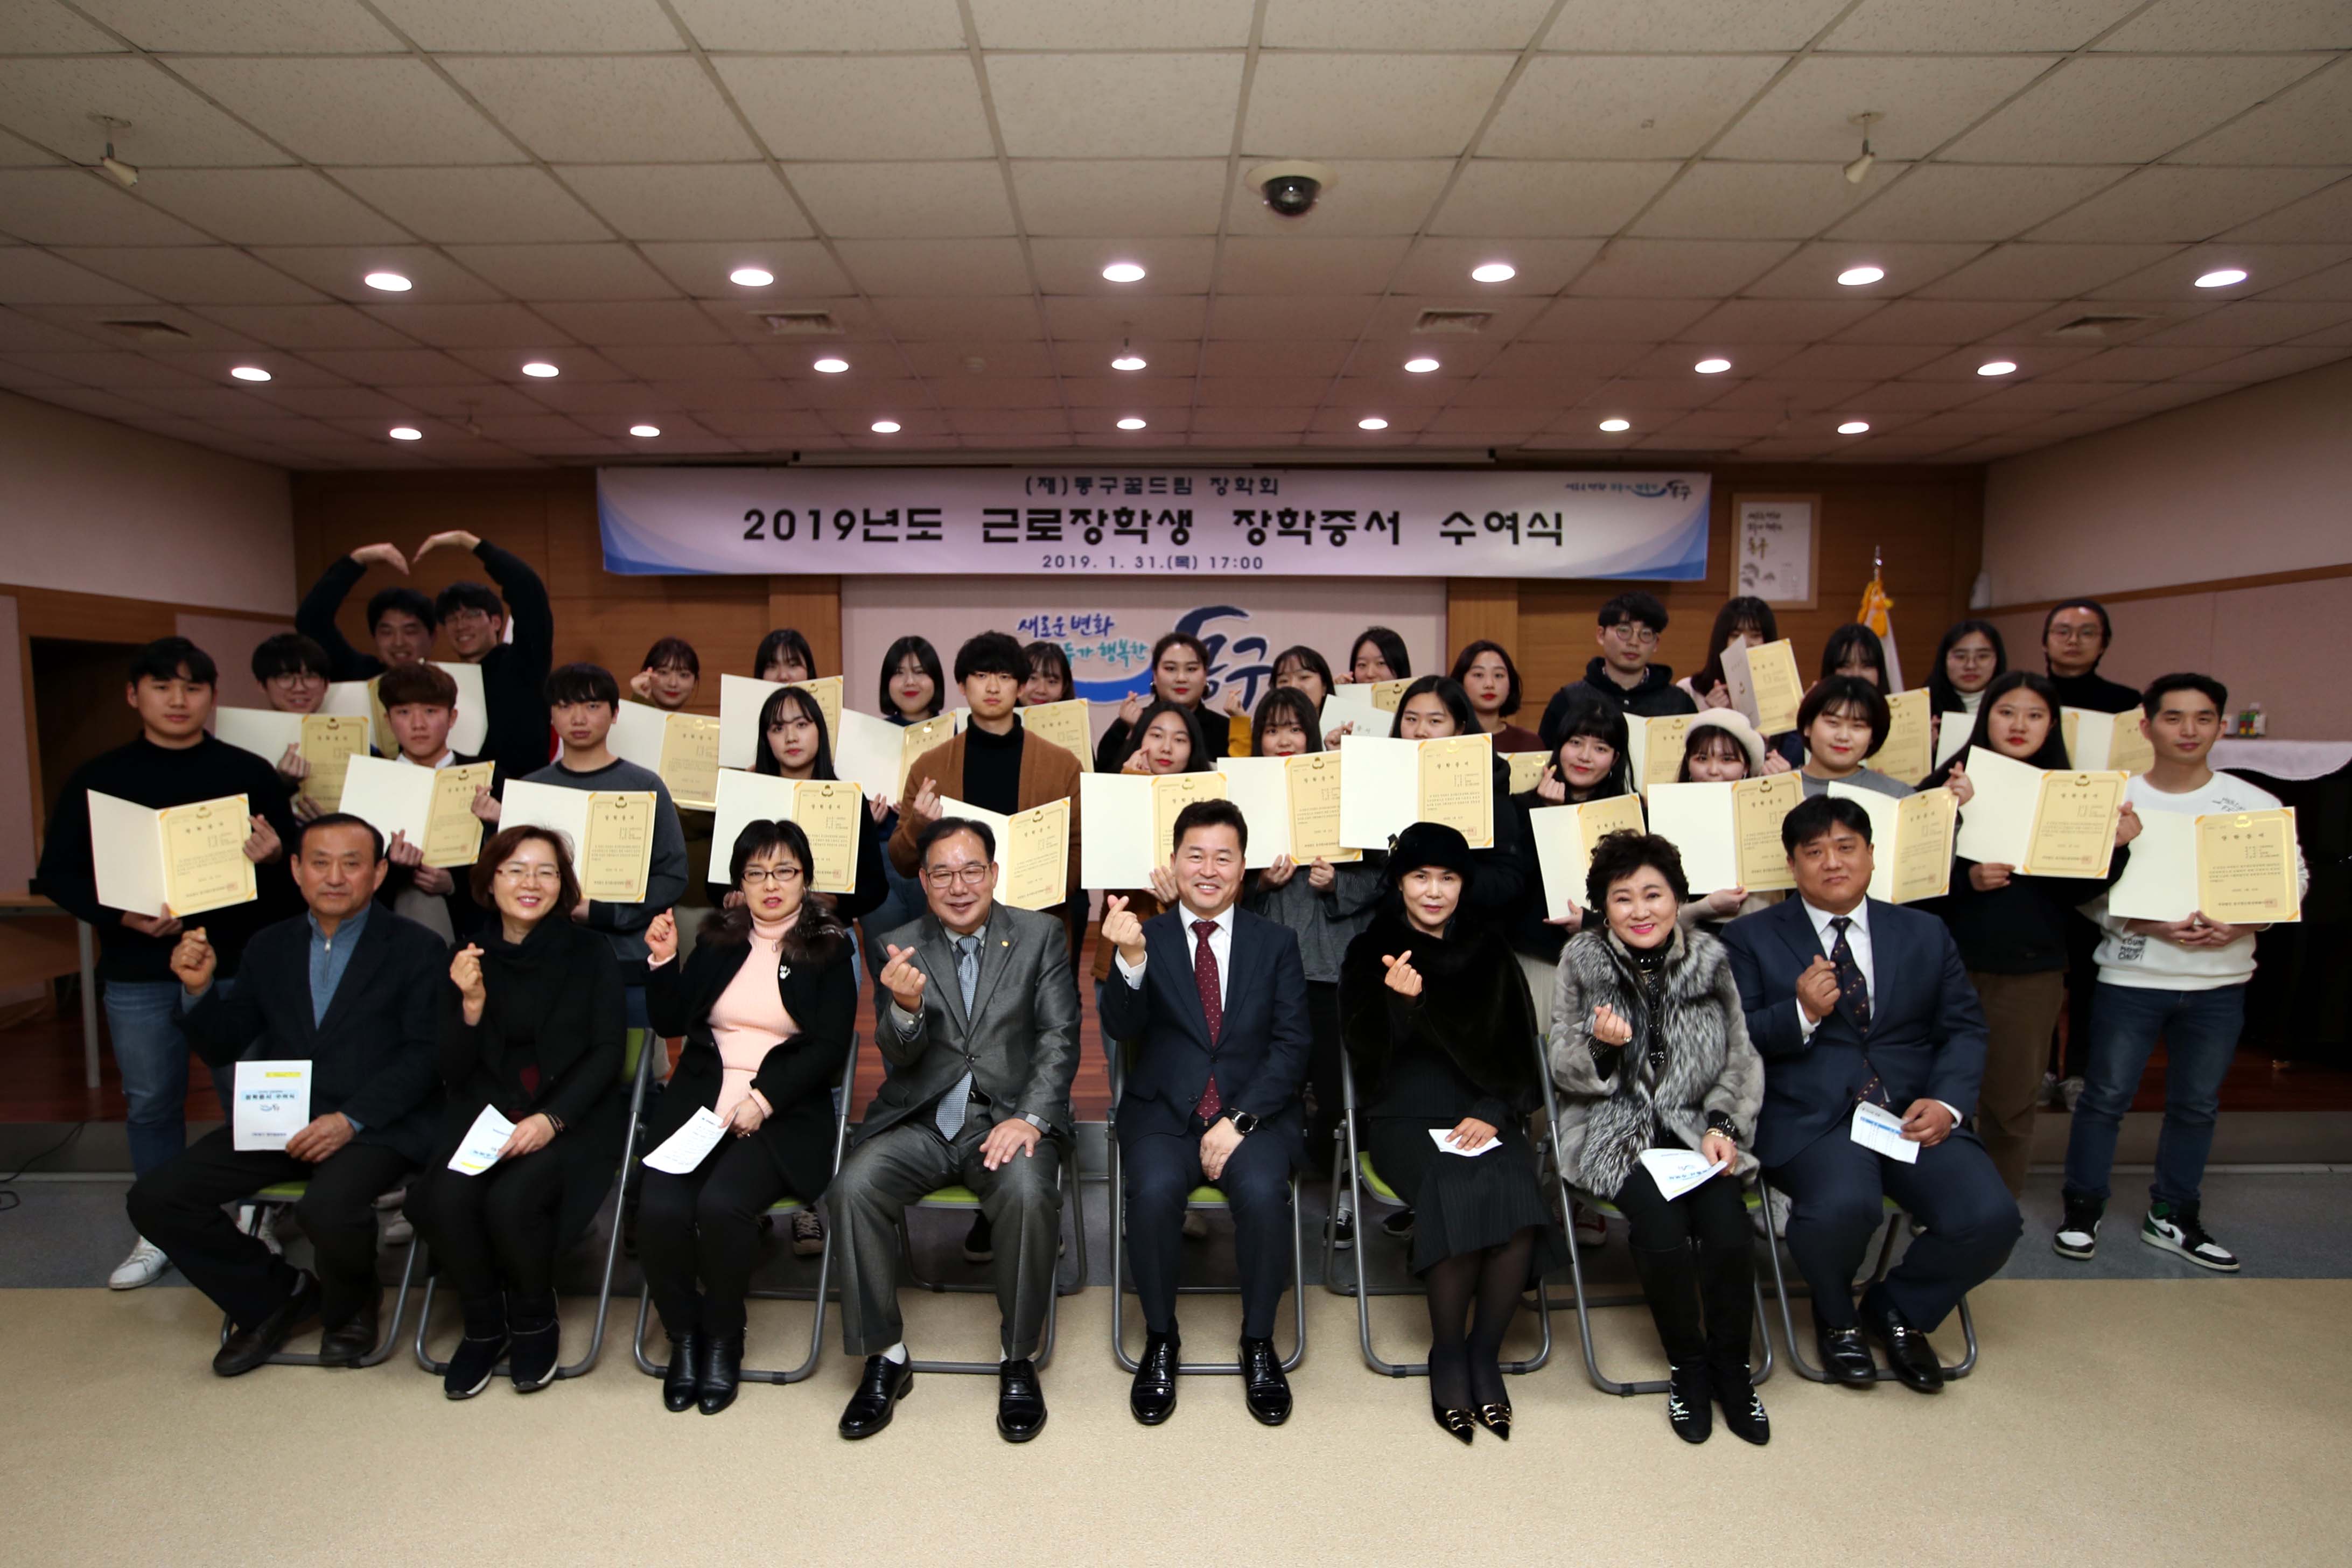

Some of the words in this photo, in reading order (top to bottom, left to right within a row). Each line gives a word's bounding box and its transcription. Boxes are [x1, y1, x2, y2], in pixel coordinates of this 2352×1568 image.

[1026, 476, 1192, 496] (재)동구꿈드림
[1209, 477, 1279, 496] 장학회
[743, 507, 943, 542] 2019년도
[982, 506, 1193, 546] 근로장학생
[1232, 507, 1400, 547] 장학증서
[1440, 511, 1562, 547] 수여식
[1042, 555, 1097, 569] 2019.
[1109, 556, 1124, 569] 1.
[1210, 556, 1263, 570] 17:00
[1017, 614, 1066, 638] 새로운
[1068, 613, 1114, 637] 변화
[1062, 642, 1093, 667] 두가
[1096, 638, 1147, 668] 행복한
